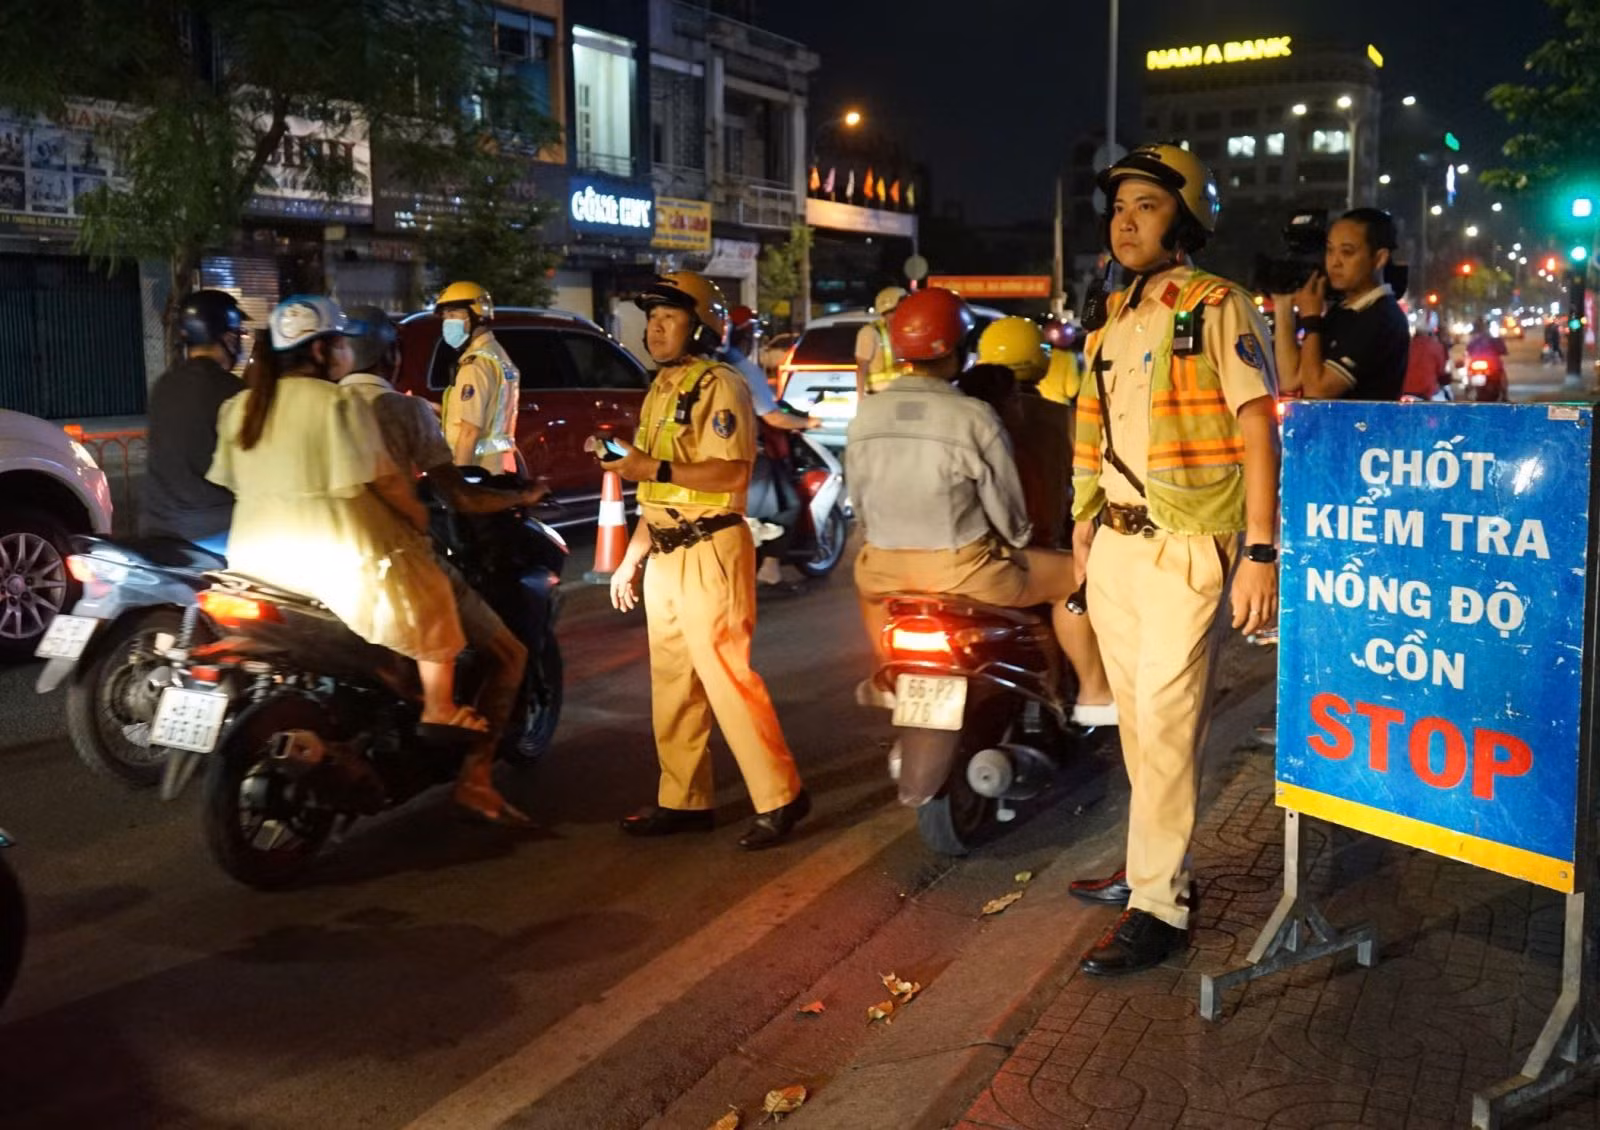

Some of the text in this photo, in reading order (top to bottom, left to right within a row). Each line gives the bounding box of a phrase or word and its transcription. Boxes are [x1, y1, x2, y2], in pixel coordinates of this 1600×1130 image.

[1147, 36, 1292, 70] NAM A BANK
[1360, 435, 1495, 491] CHỐT
[1306, 488, 1550, 560] KIỂM TRA
[1306, 557, 1524, 639] NỒNG ĐỘ
[1364, 629, 1465, 690] CỒN
[1307, 692, 1534, 801] STOP
